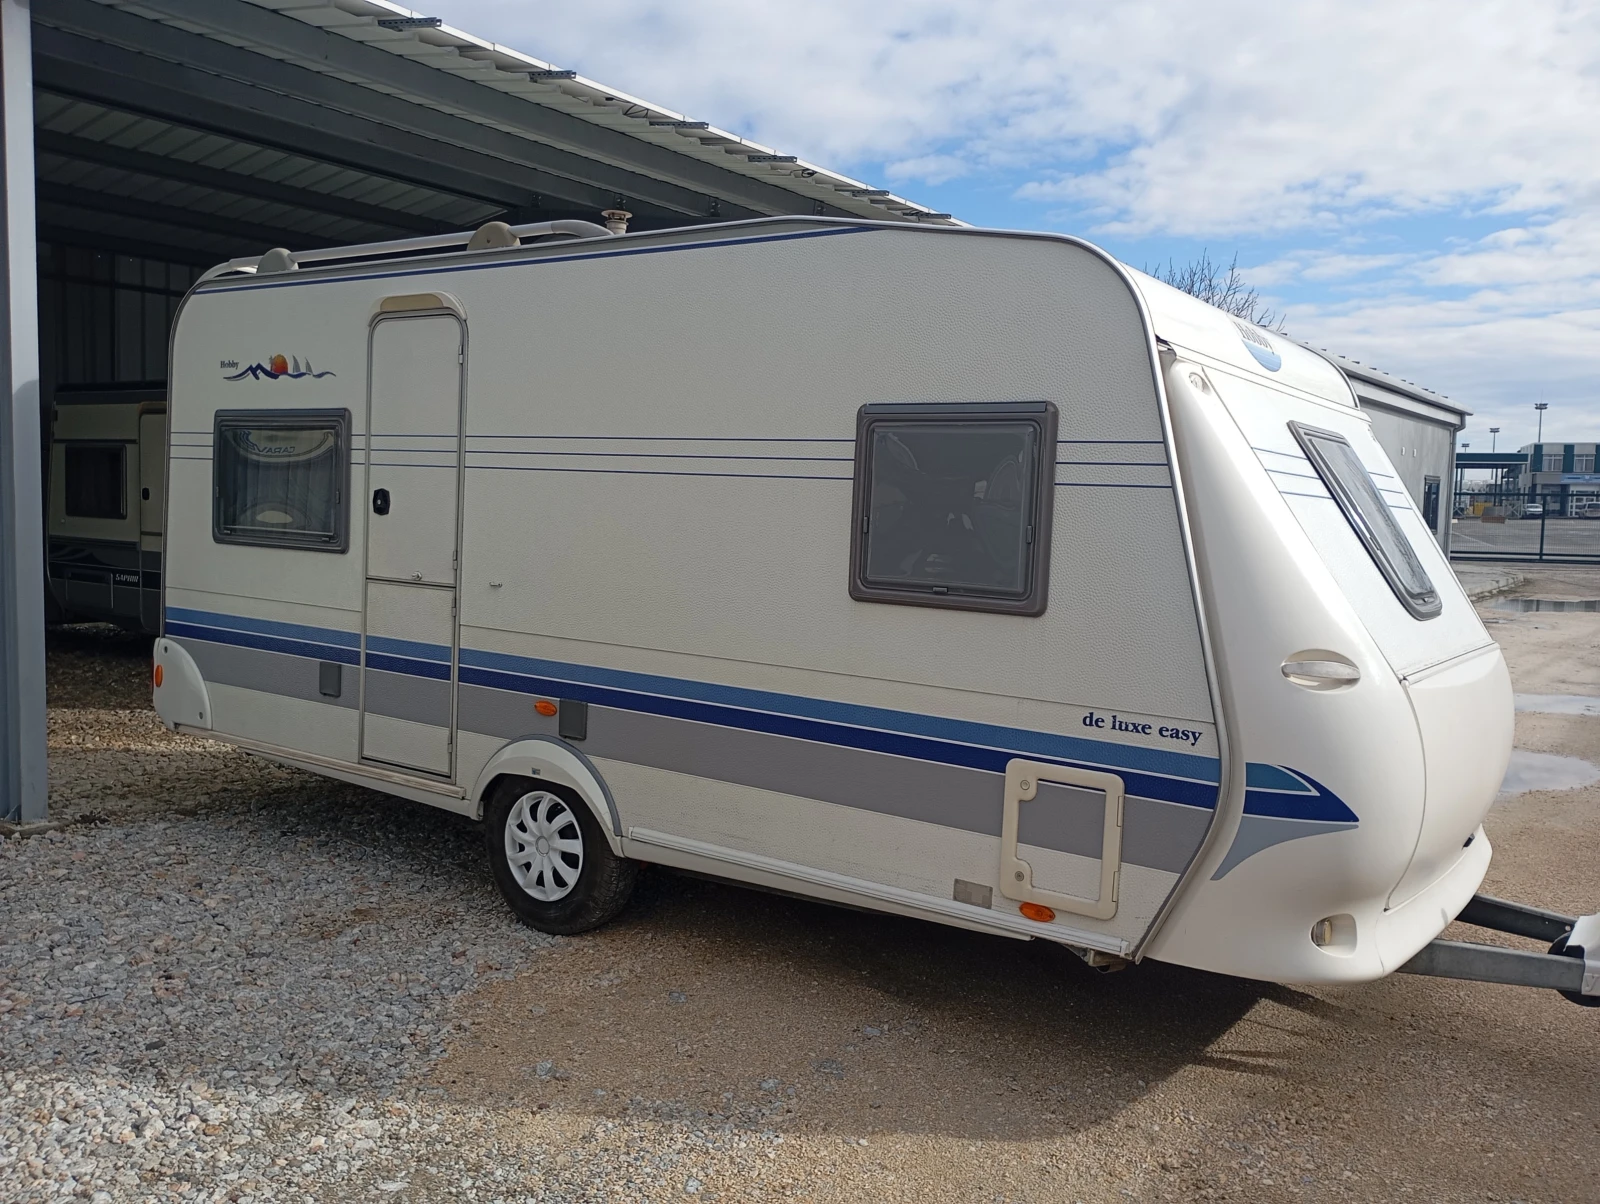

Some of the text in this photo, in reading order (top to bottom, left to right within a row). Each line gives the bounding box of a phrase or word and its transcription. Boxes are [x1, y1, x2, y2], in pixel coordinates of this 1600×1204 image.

[220, 360, 239, 370] Hobby
[1082, 711, 1203, 746] de luxe easy
